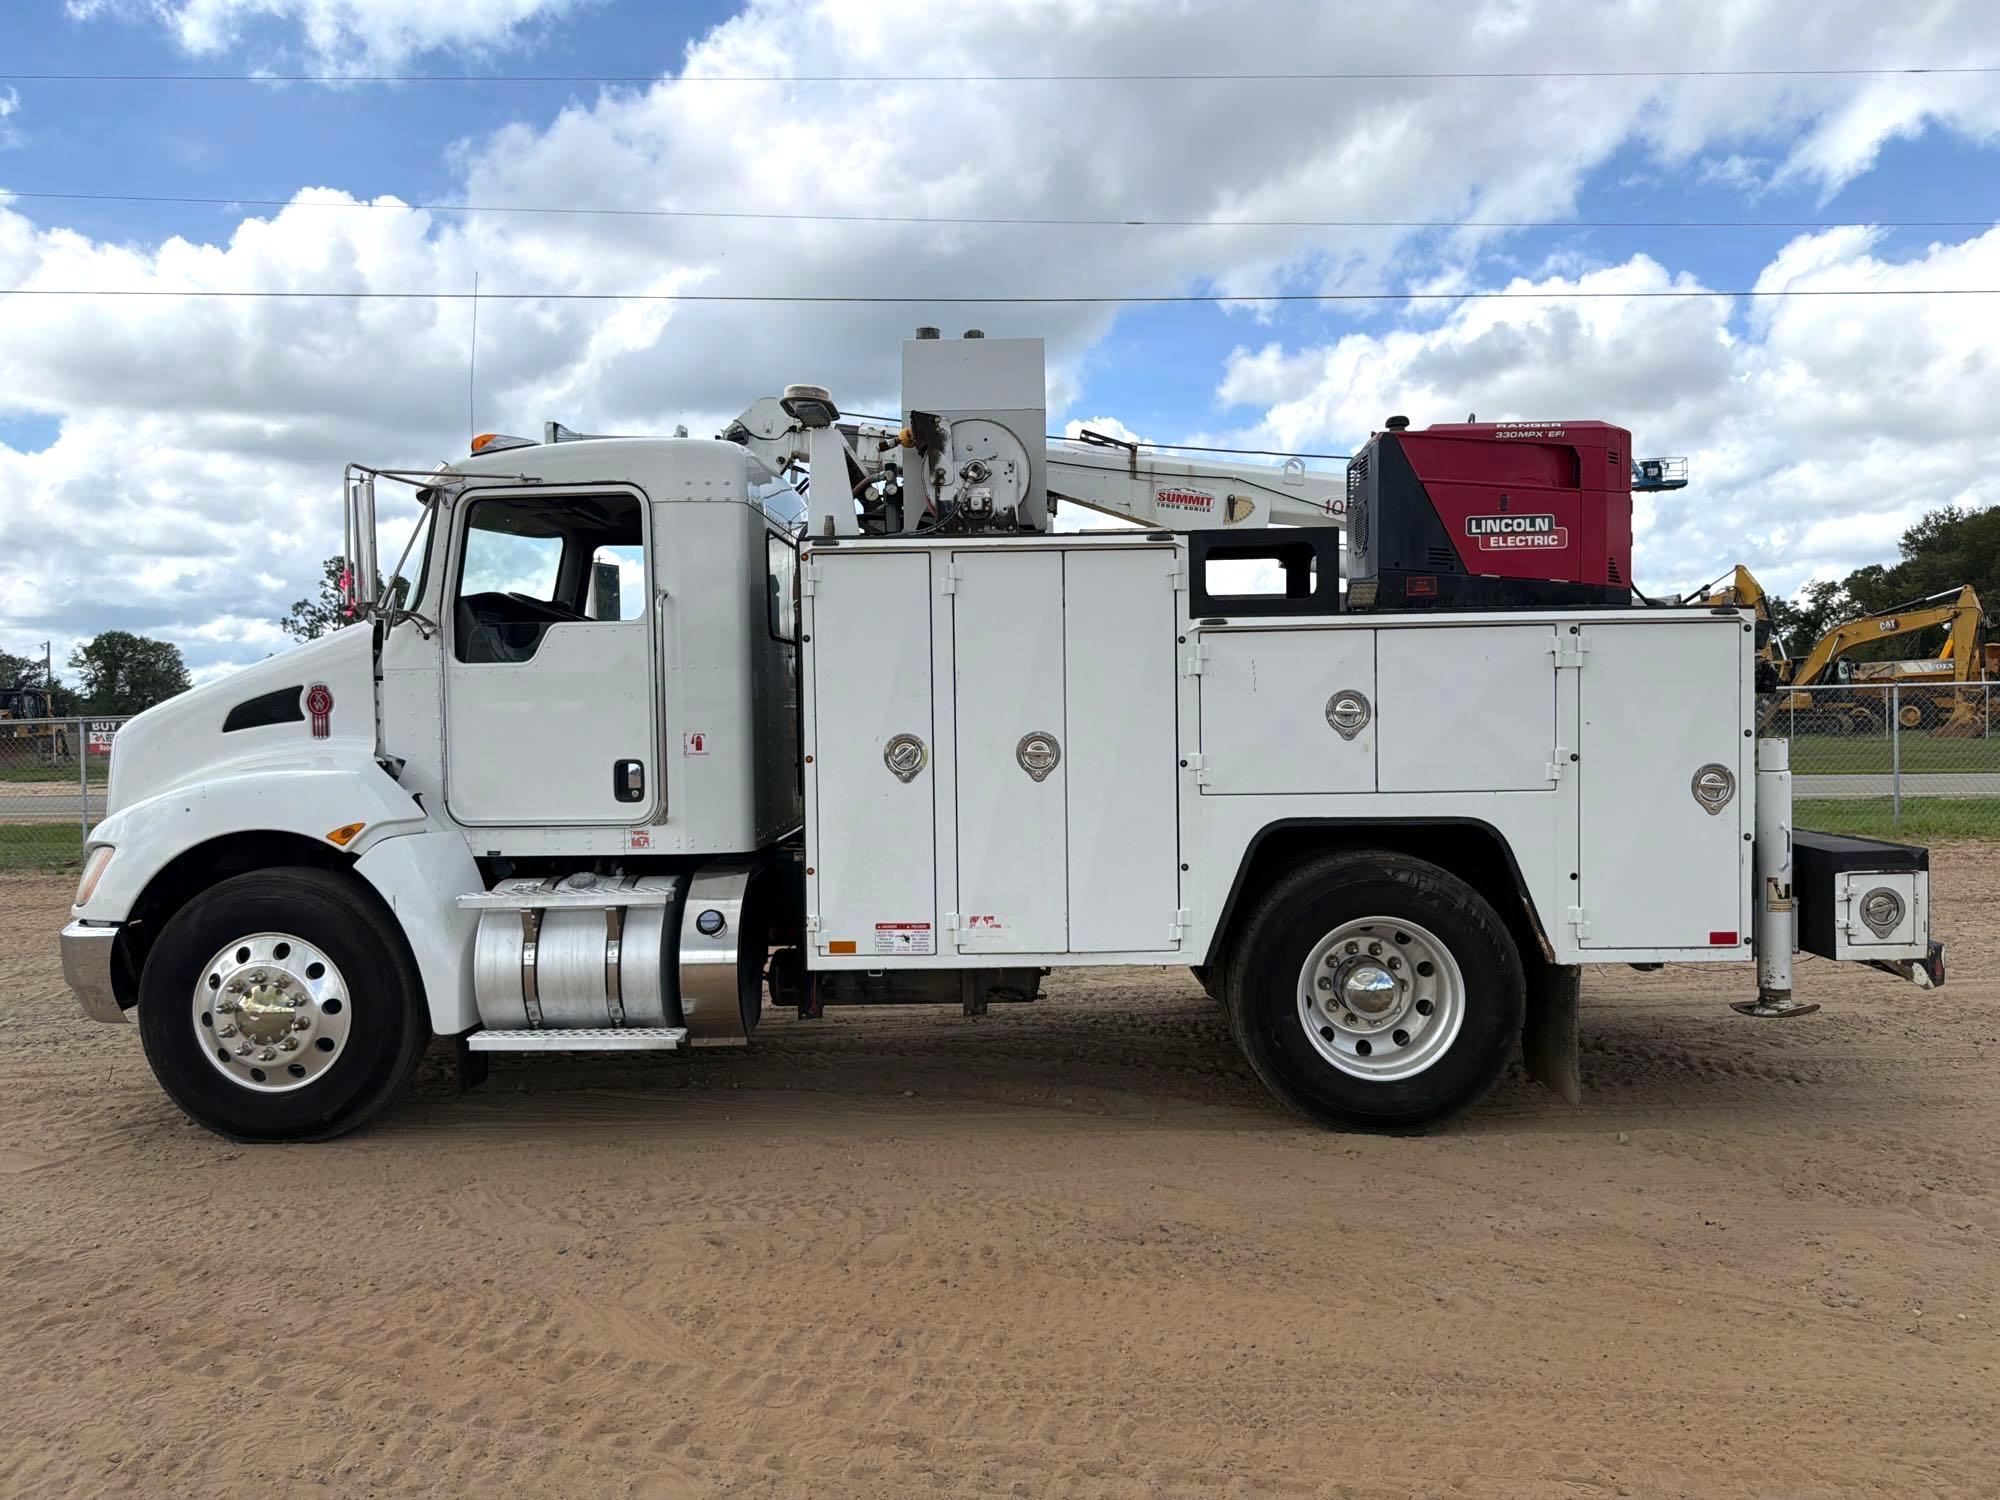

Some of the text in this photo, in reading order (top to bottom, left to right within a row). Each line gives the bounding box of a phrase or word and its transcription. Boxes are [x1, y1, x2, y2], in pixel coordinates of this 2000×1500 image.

[1157, 492, 1213, 506] SUMMIT
[1471, 517, 1549, 533] LINCOLN
[1490, 535, 1559, 547] ELECTRIC
[1880, 619, 1896, 631] CAT
[92, 722, 116, 731] BUY
